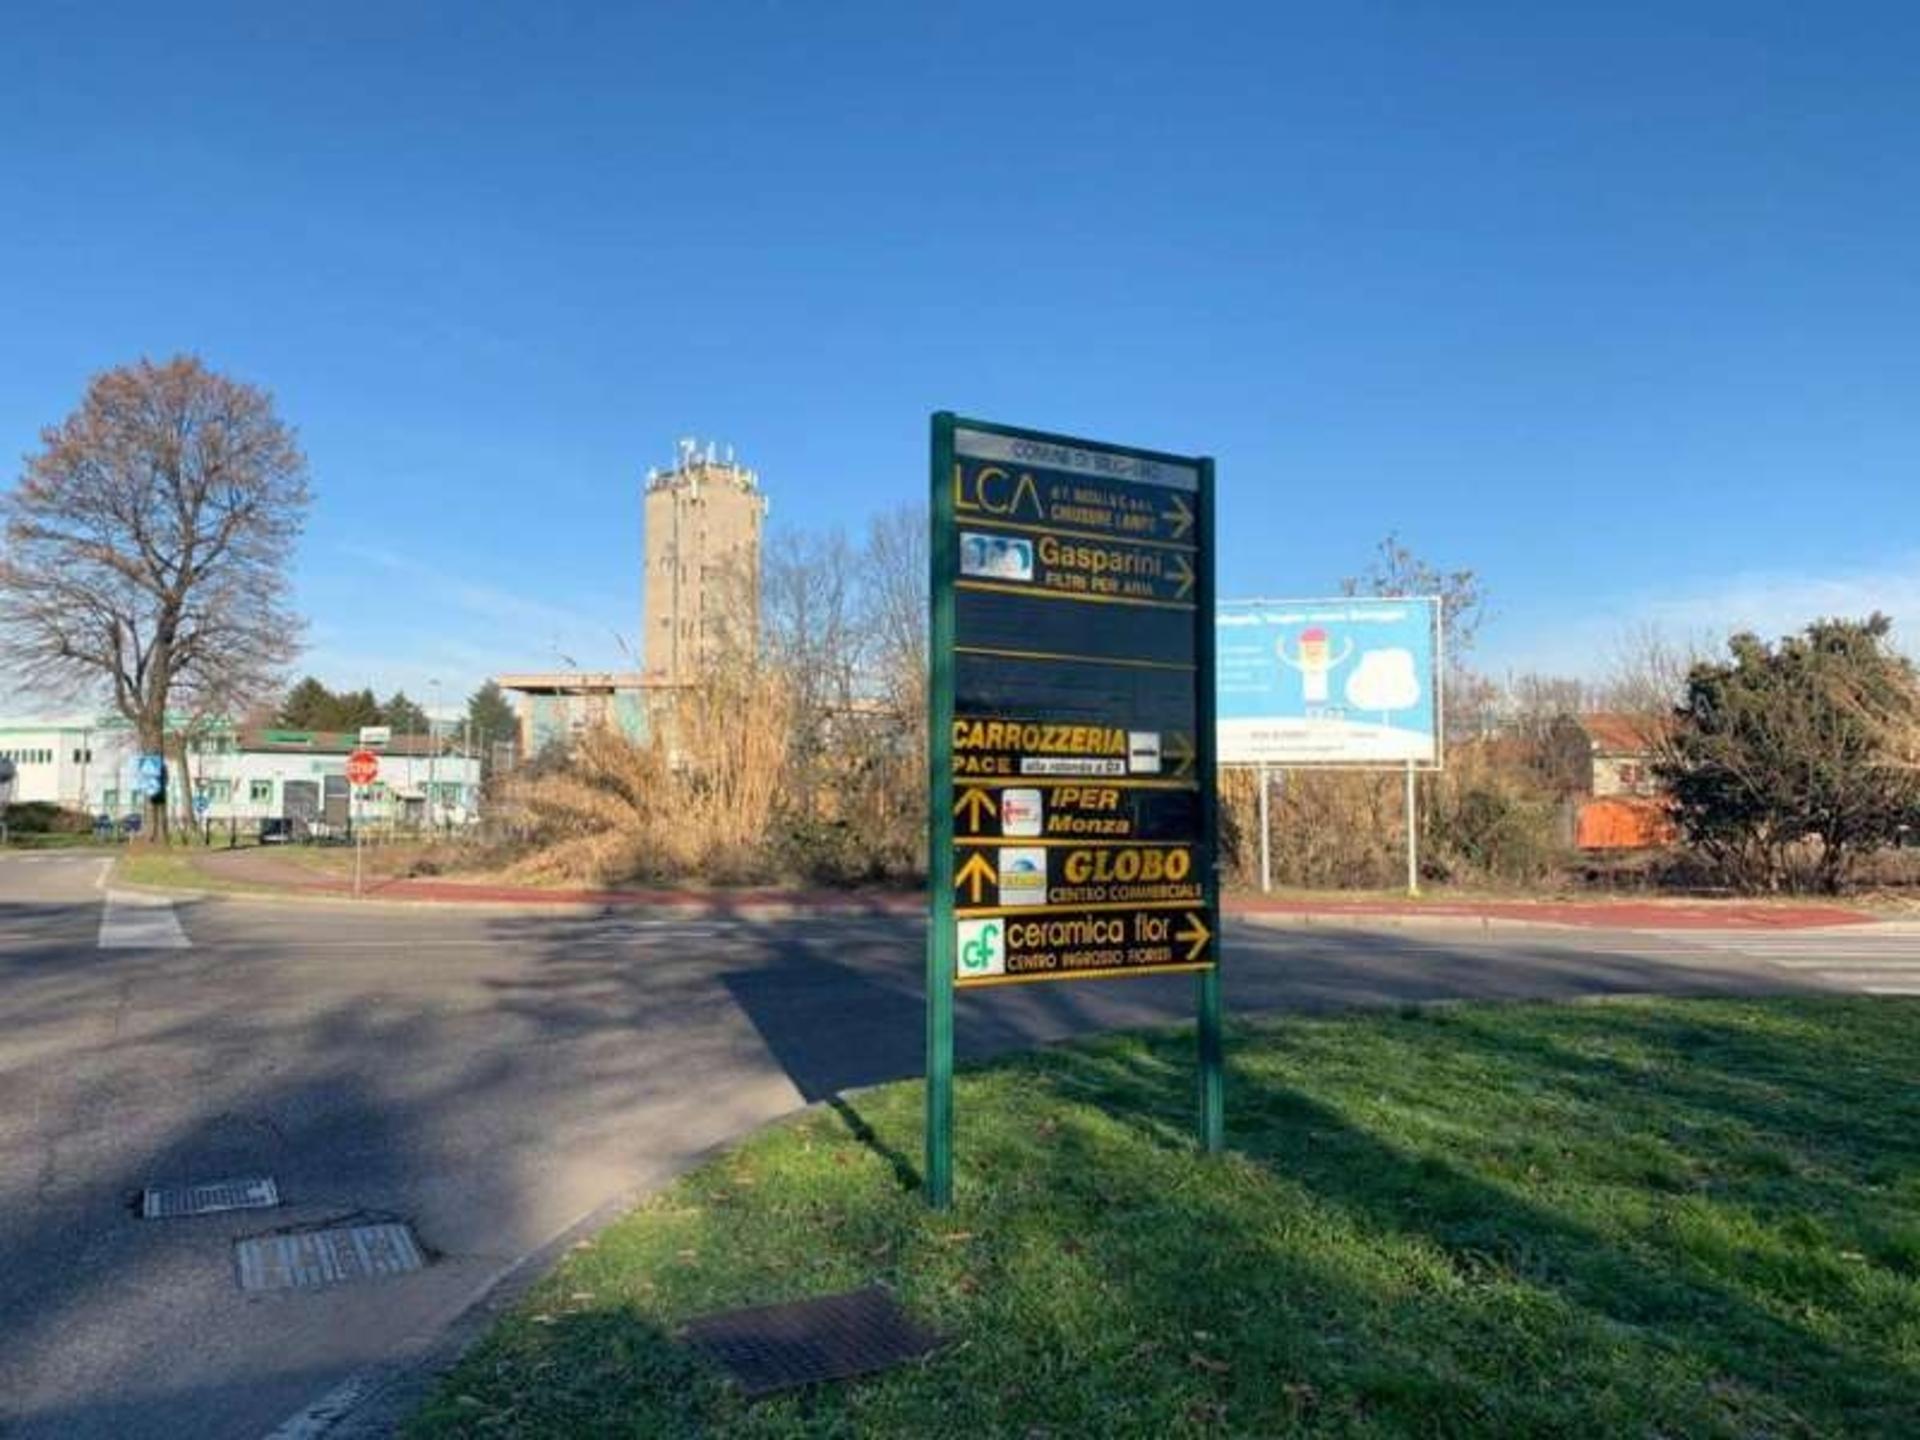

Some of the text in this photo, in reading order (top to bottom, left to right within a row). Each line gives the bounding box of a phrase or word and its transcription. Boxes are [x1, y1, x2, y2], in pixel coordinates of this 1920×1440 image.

[954, 463, 1043, 519] LCA
[1039, 536, 1162, 577] Gasparini
[952, 721, 1126, 754] CARROZZERIA
[952, 757, 1011, 774] PACE
[1050, 787, 1120, 810] IPER
[1047, 814, 1130, 834] Monza
[1064, 848, 1190, 884] GLOBO
[1050, 886, 1106, 903] CENTRO
[1007, 915, 1125, 949] ceramica
